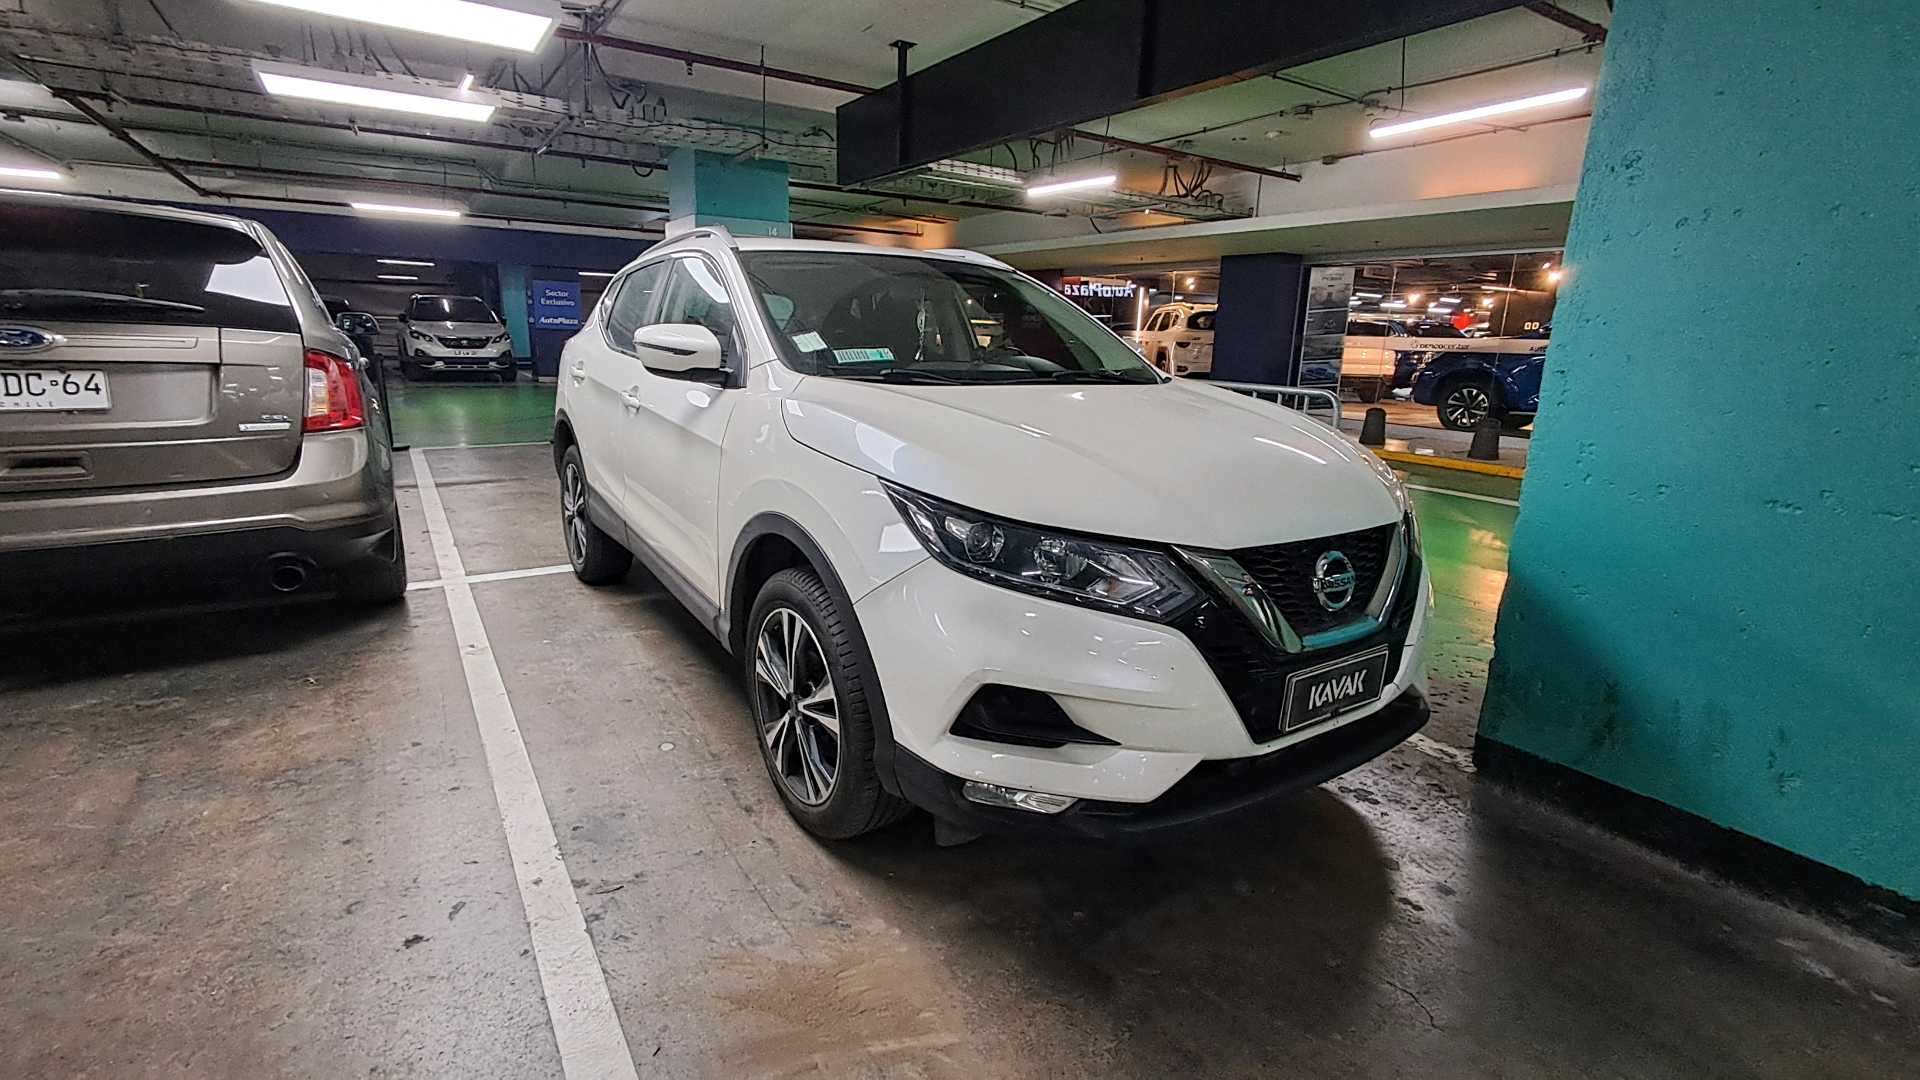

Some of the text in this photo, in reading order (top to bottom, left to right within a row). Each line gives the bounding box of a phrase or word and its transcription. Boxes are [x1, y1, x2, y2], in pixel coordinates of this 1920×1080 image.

[545, 289, 568, 297] Sector
[539, 317, 578, 325] AutoPlaza
[1308, 669, 1368, 710] KAVAK
